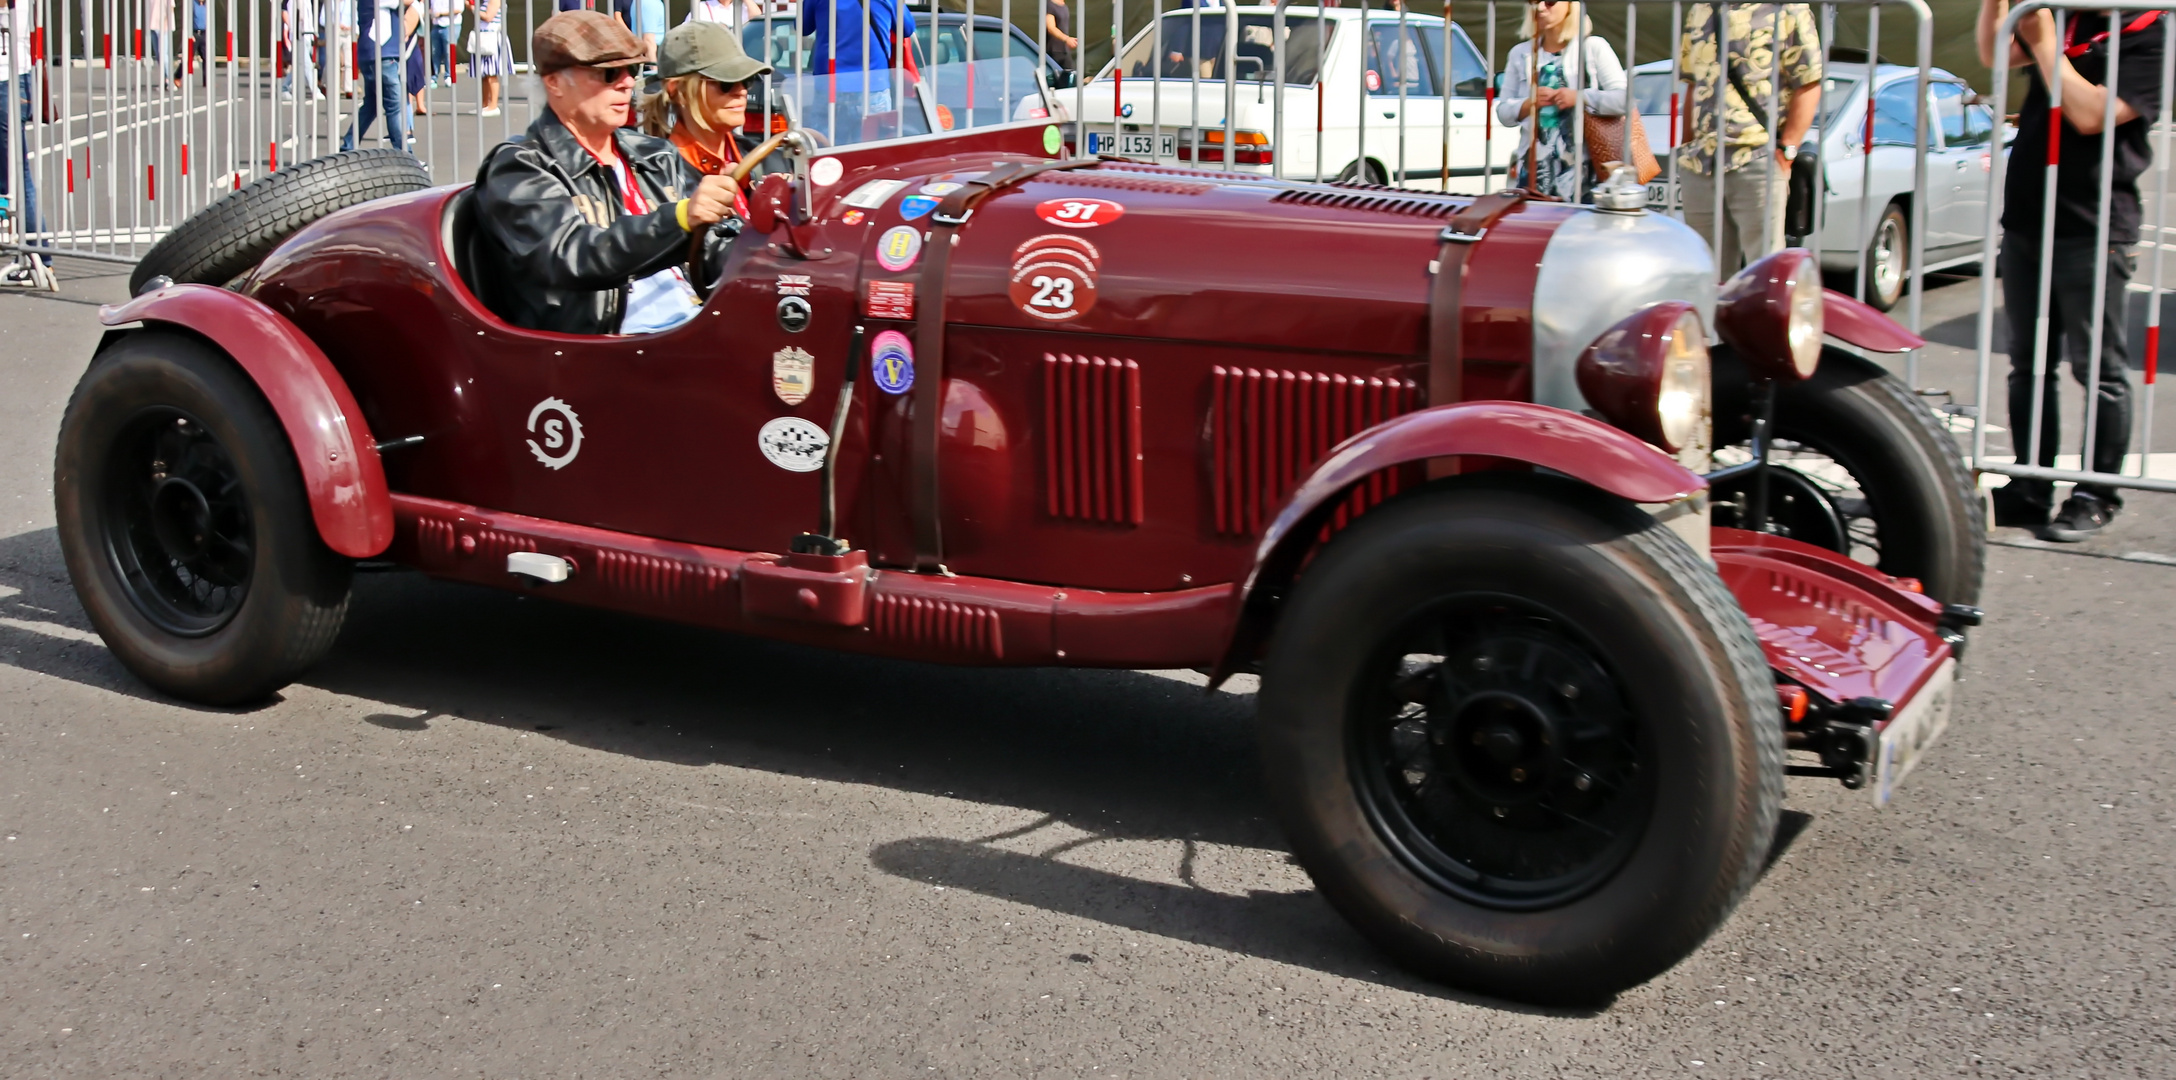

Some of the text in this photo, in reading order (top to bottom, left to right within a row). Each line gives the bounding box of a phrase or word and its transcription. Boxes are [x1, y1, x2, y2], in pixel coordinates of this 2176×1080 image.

[1097, 136, 1115, 152] HP
[1055, 201, 1101, 220] 31
[888, 233, 911, 256] H
[1030, 276, 1074, 308] 23
[884, 358, 904, 385] V
[544, 419, 563, 448] S
